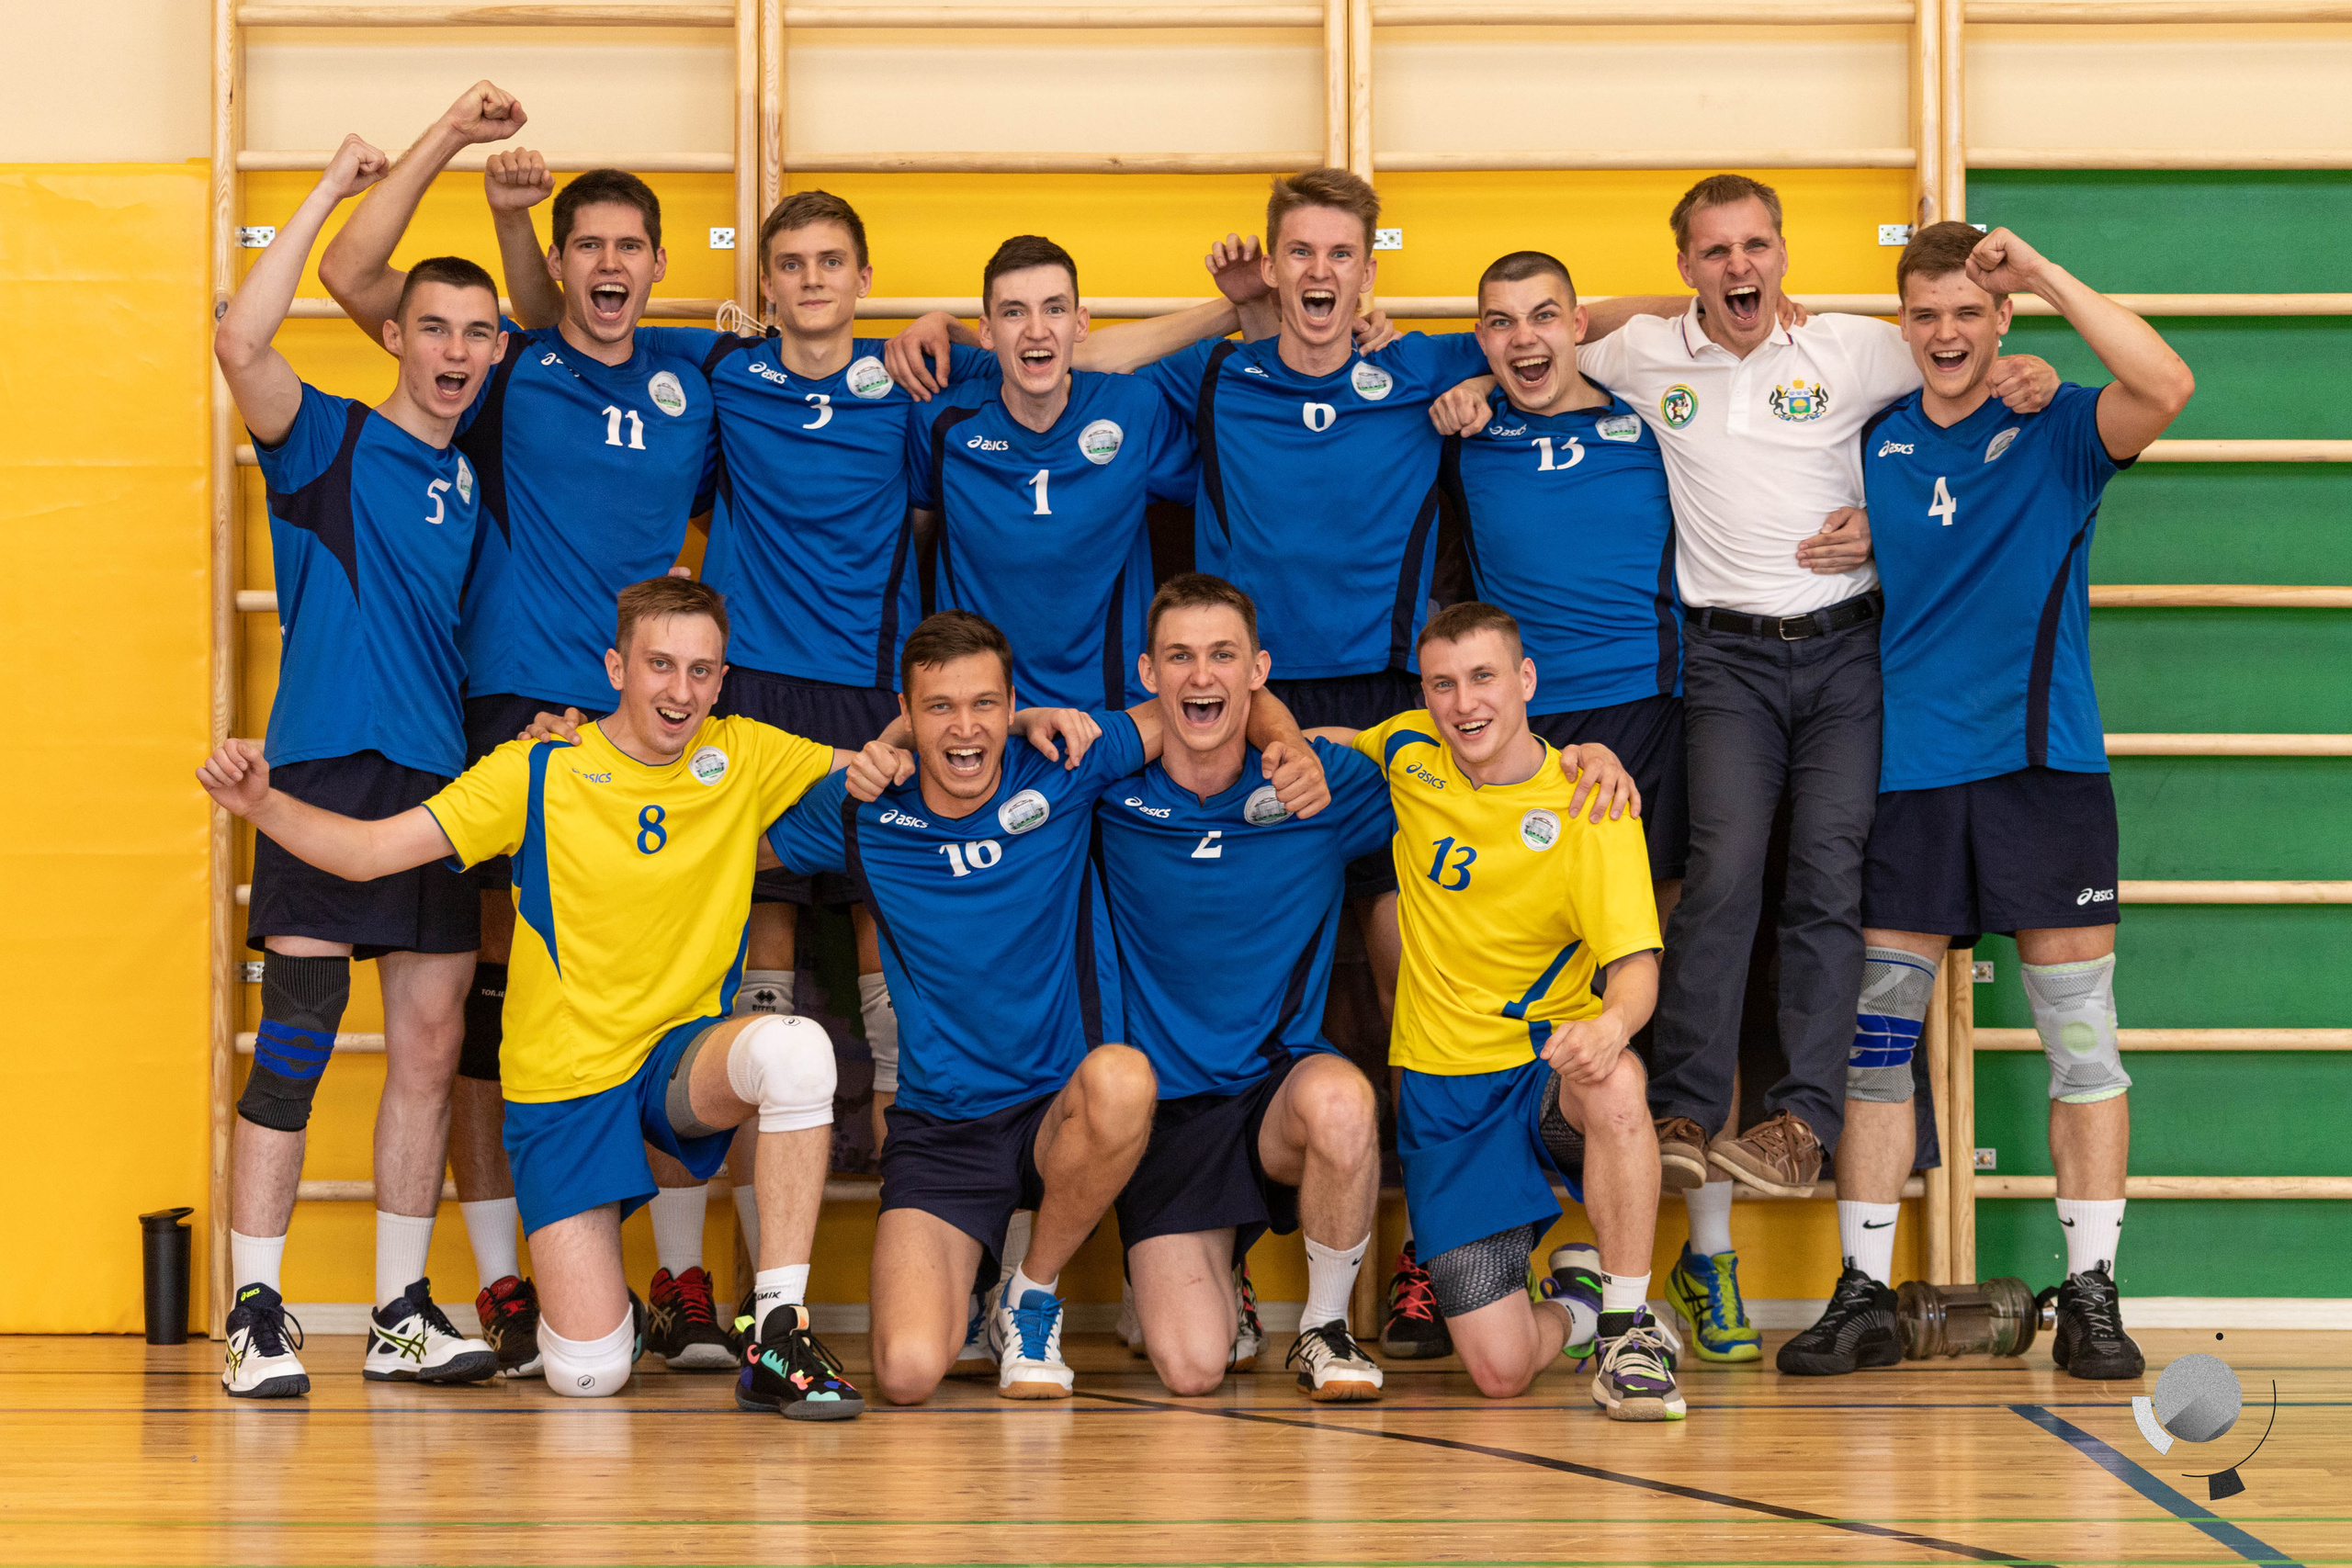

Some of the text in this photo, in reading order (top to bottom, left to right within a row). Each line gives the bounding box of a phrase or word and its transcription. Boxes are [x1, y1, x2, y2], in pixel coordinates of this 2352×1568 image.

[603, 405, 646, 450] 11
[803, 393, 832, 430] 3
[1532, 436, 1585, 471] 13
[425, 478, 451, 525] 5
[1029, 469, 1052, 514] 1
[1928, 477, 1956, 525] 4
[637, 805, 666, 855] 8
[1427, 837, 1476, 891] 13
